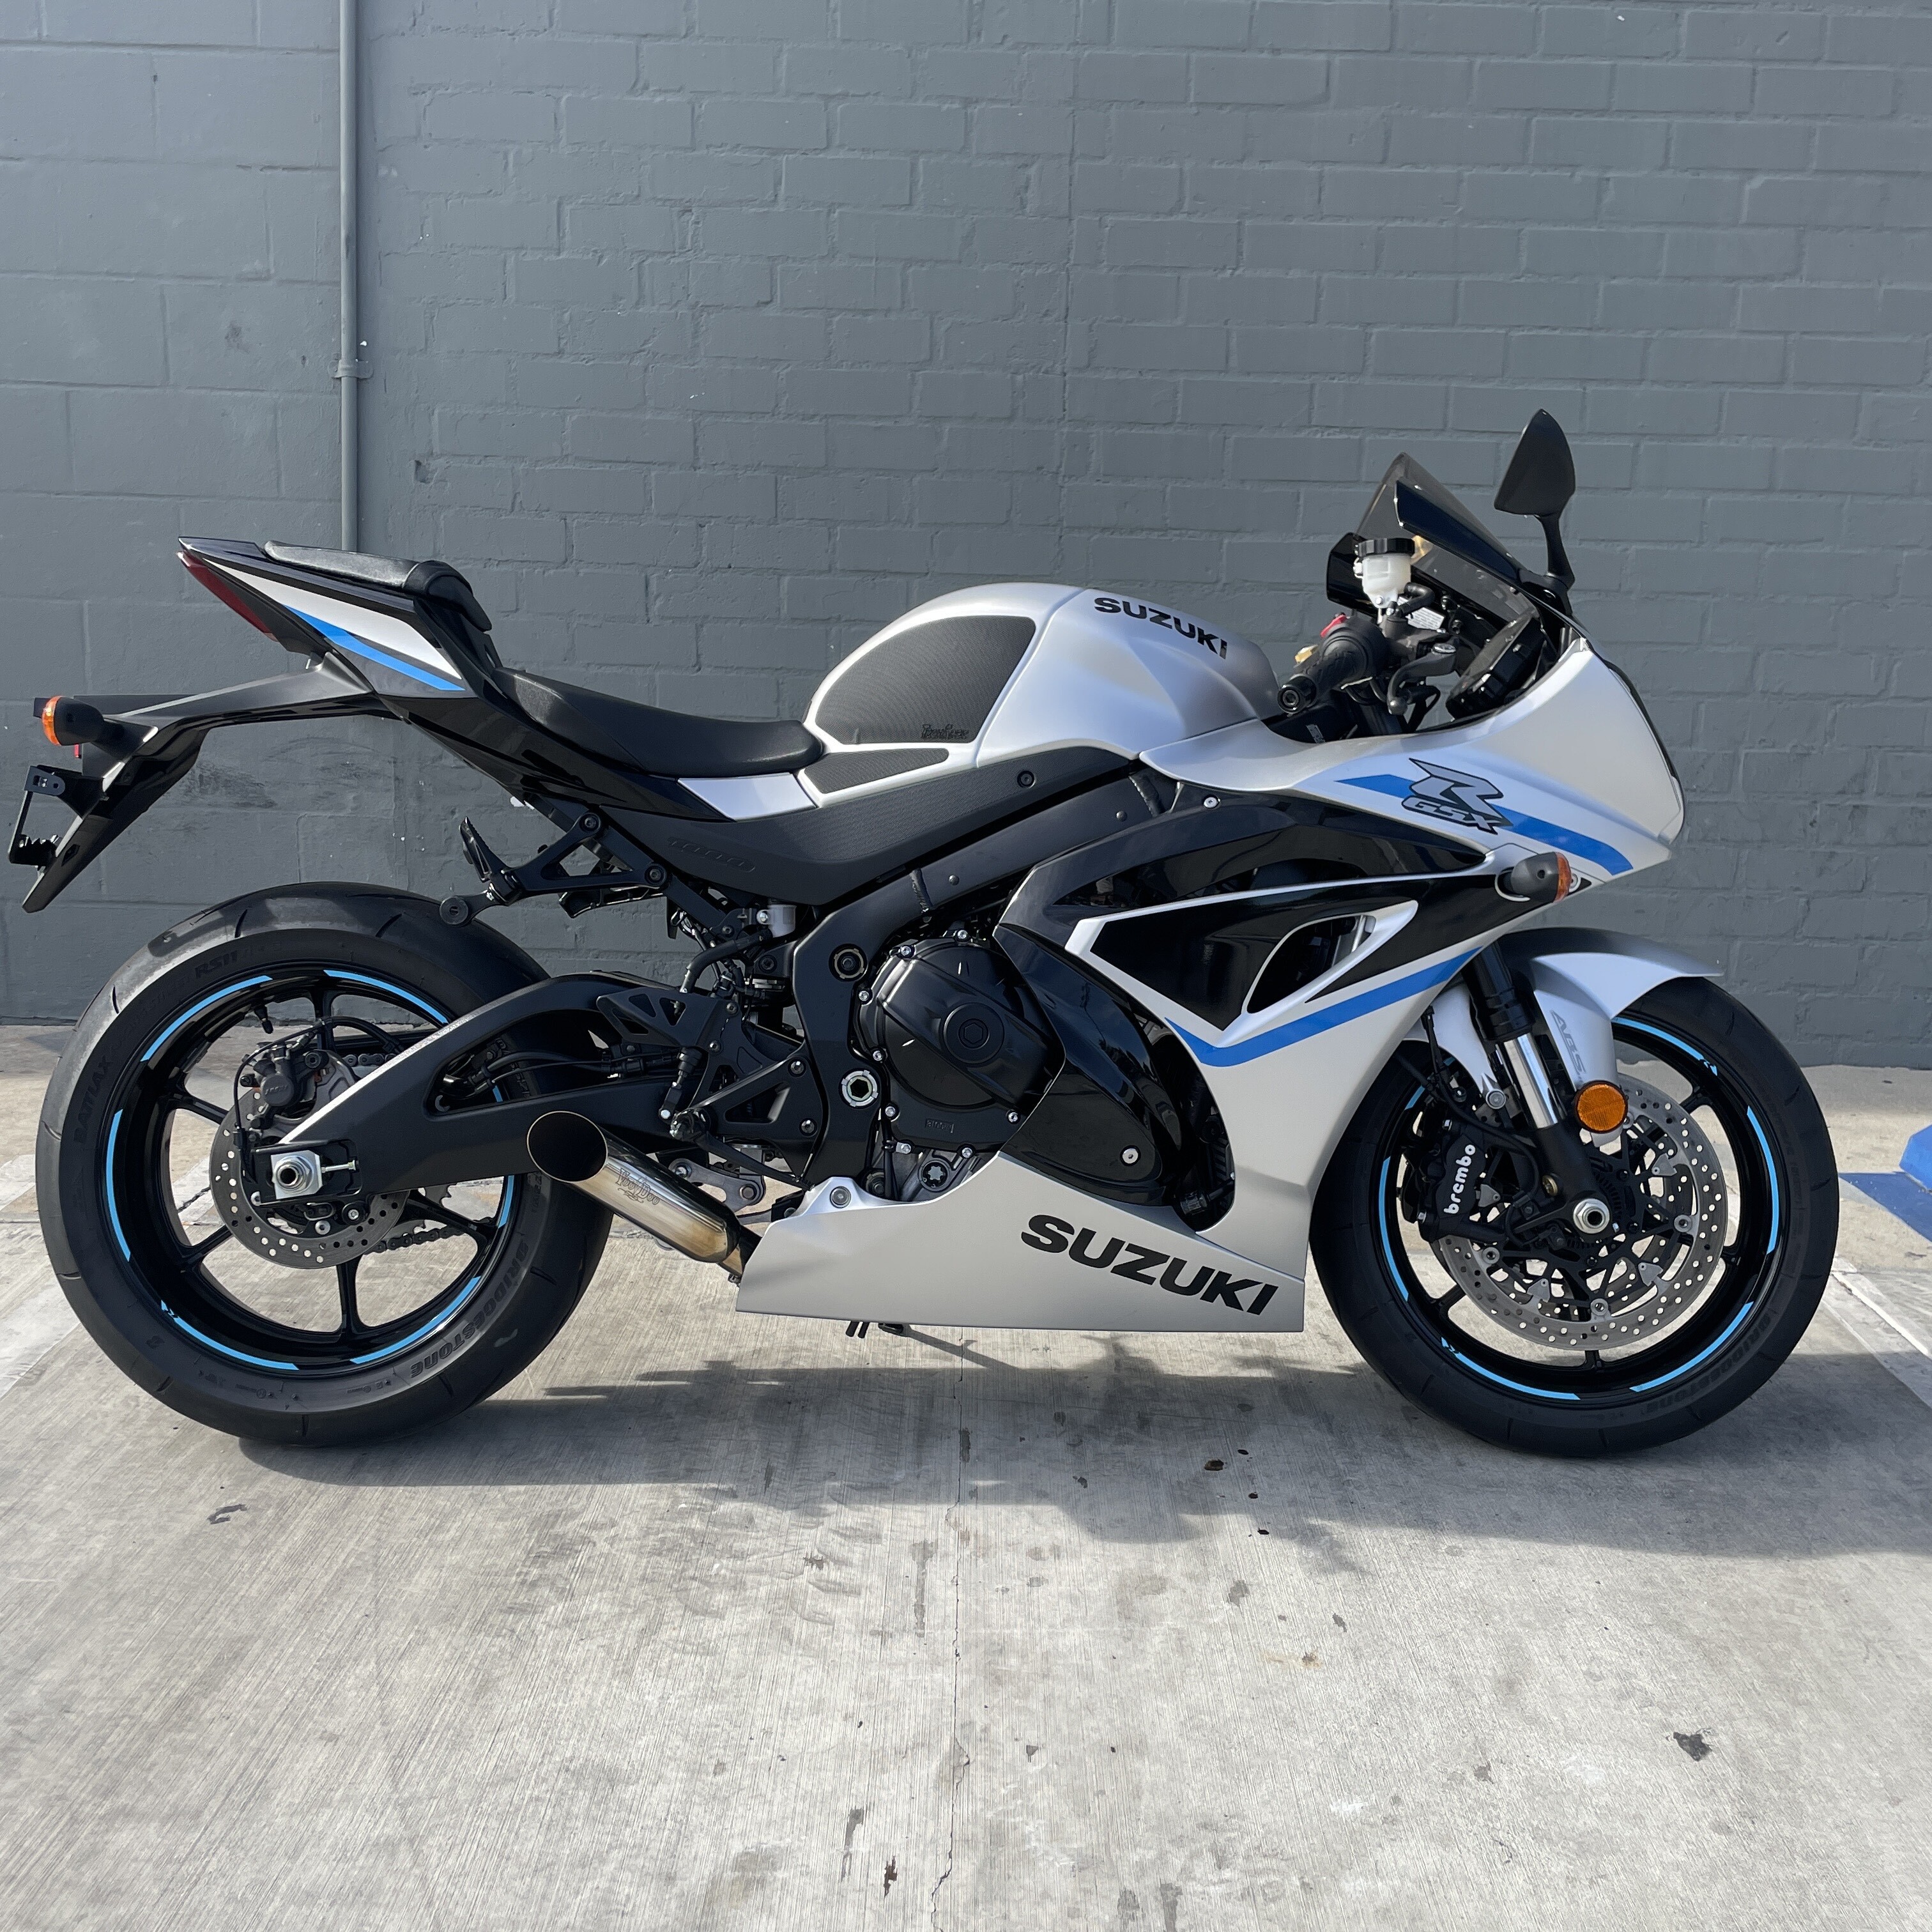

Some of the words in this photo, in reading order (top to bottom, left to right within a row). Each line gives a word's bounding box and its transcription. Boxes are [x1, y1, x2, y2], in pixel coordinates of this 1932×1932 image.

[1094, 597, 1228, 660] SUZUKI
[1400, 795, 1503, 836] GSX
[1549, 1009, 1587, 1076] ABS
[1443, 1144, 1476, 1215] brembo
[1021, 1215, 1279, 1316] SUZUKI
[410, 1241, 530, 1378] BRIDGESTONE
